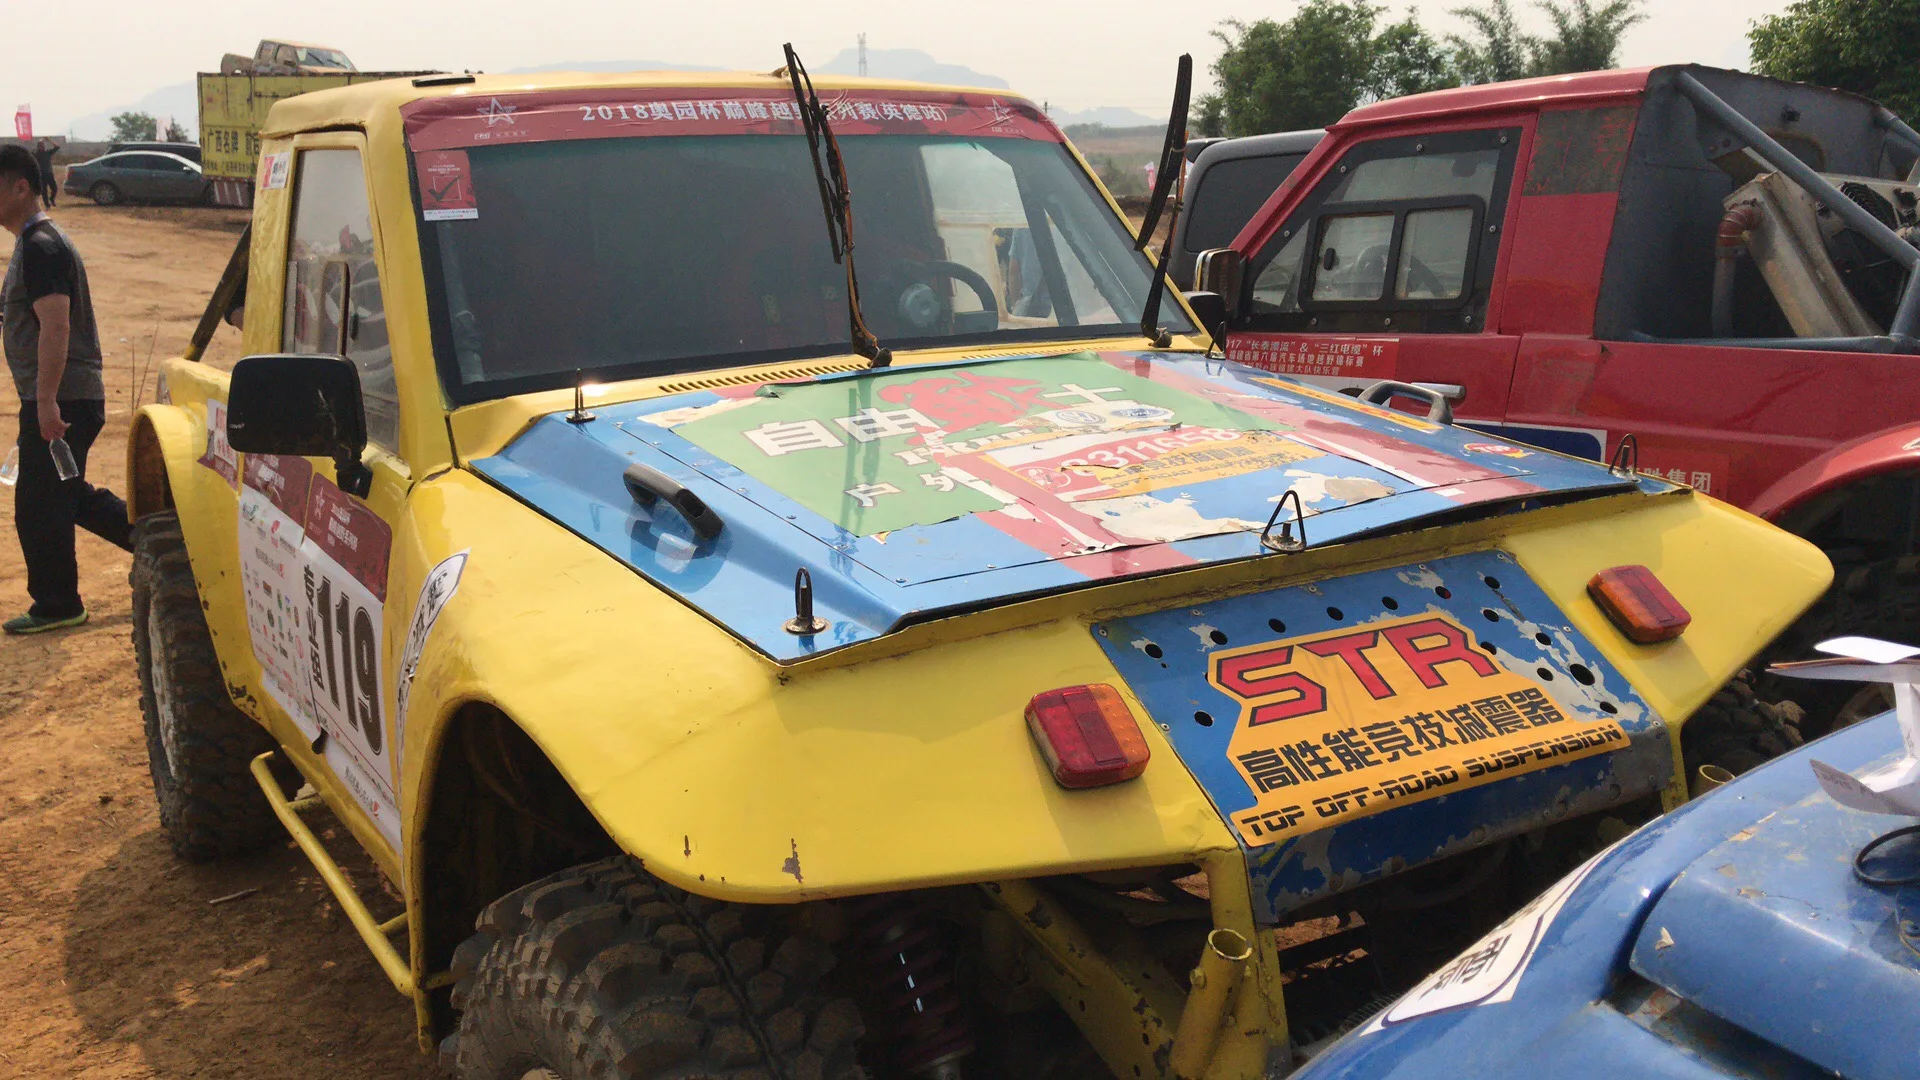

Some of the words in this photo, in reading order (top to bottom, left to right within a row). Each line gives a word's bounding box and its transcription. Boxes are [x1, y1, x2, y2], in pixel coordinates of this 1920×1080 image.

[1372, 345, 1384, 357] 杯
[317, 576, 383, 756] 119
[1216, 618, 1500, 727] STR
[1236, 687, 1565, 793] 高性能竞技减震器
[1241, 805, 1305, 836] TOP
[1311, 765, 1459, 819] OFF-ROAD
[1462, 724, 1622, 778] SUSPENSION
